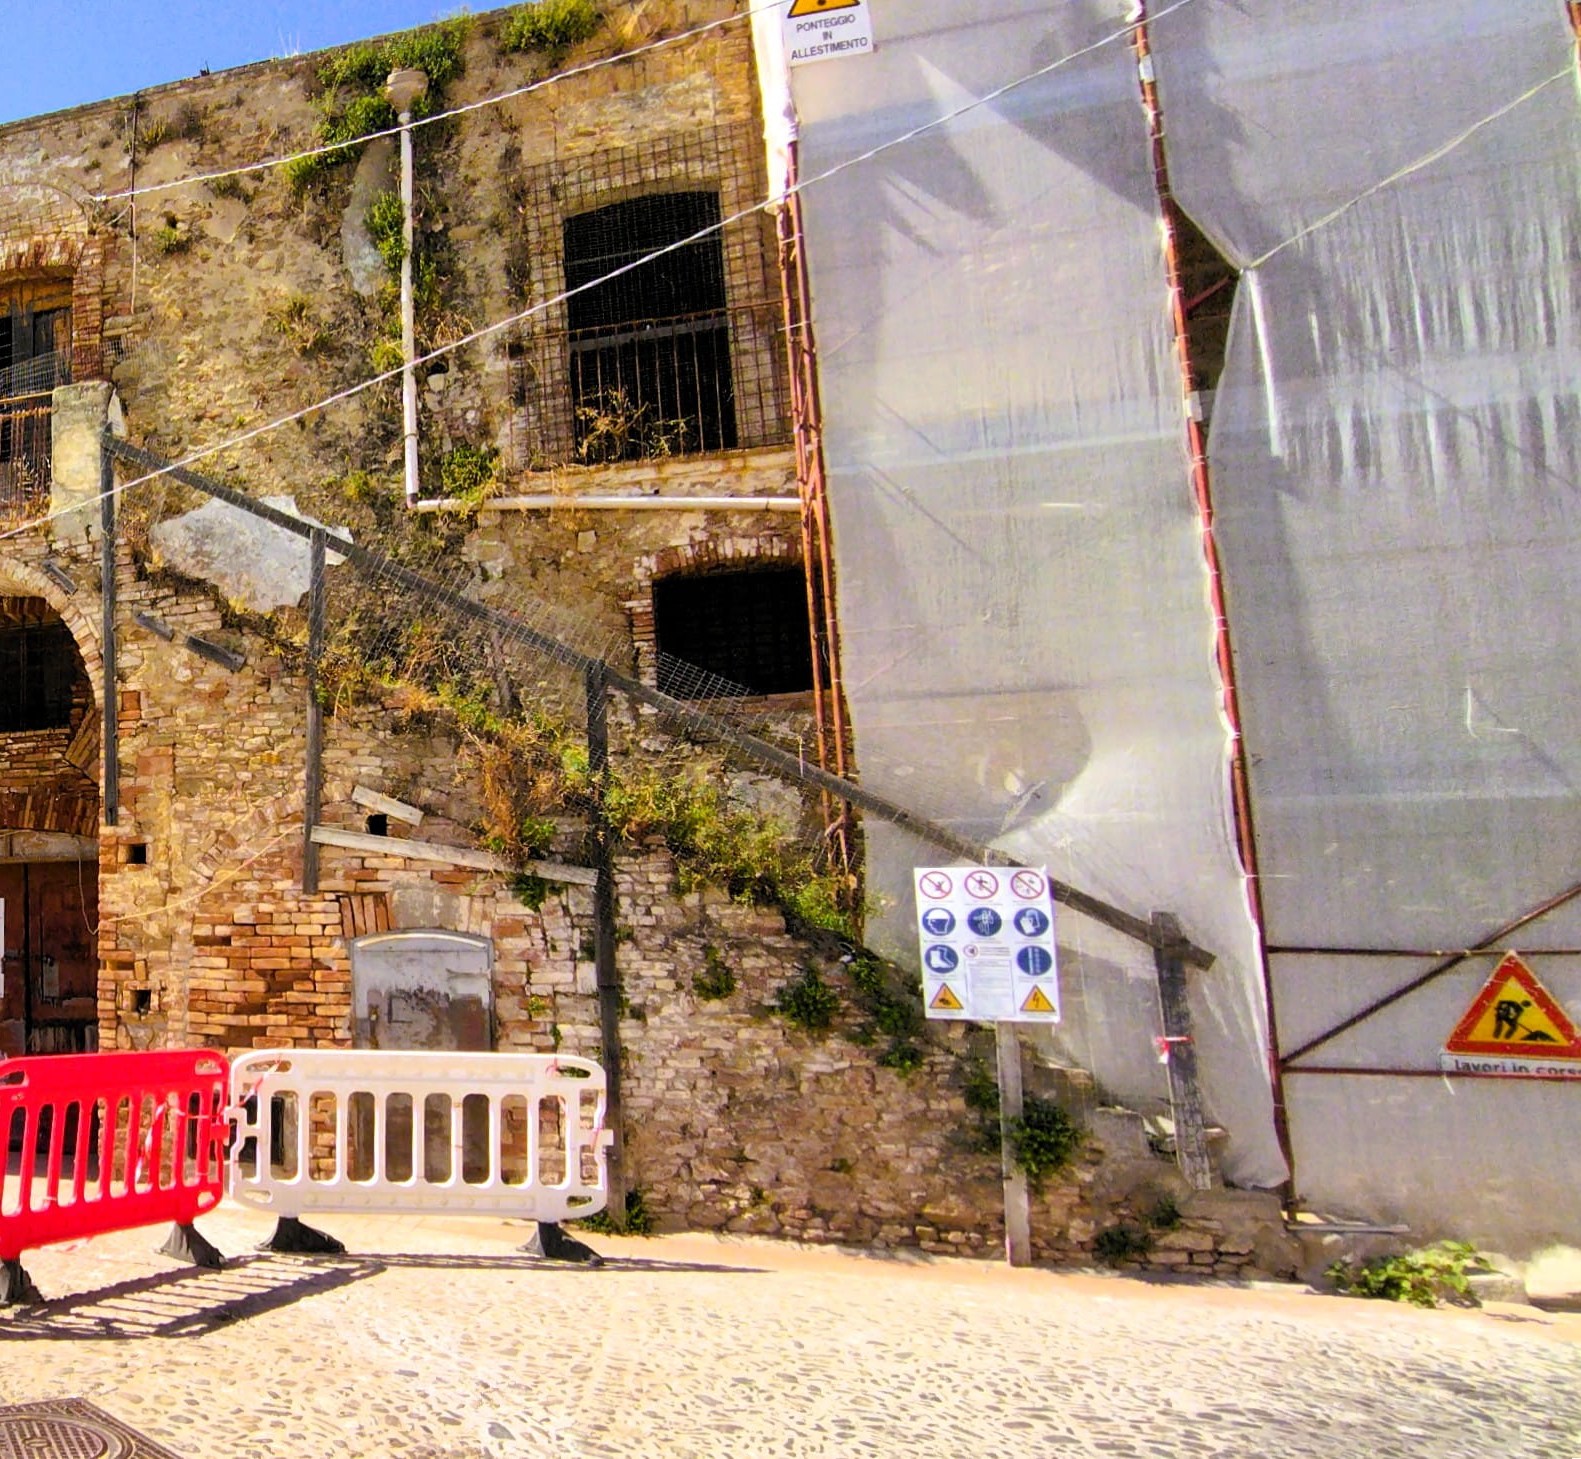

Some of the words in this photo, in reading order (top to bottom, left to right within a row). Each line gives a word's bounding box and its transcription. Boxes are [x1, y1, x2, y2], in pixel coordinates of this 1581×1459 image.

[796, 14, 856, 33] PONTEGGIO
[822, 31, 833, 41] IN
[791, 37, 868, 60] ALLESTIMENTO
[1454, 1059, 1507, 1073] lavori
